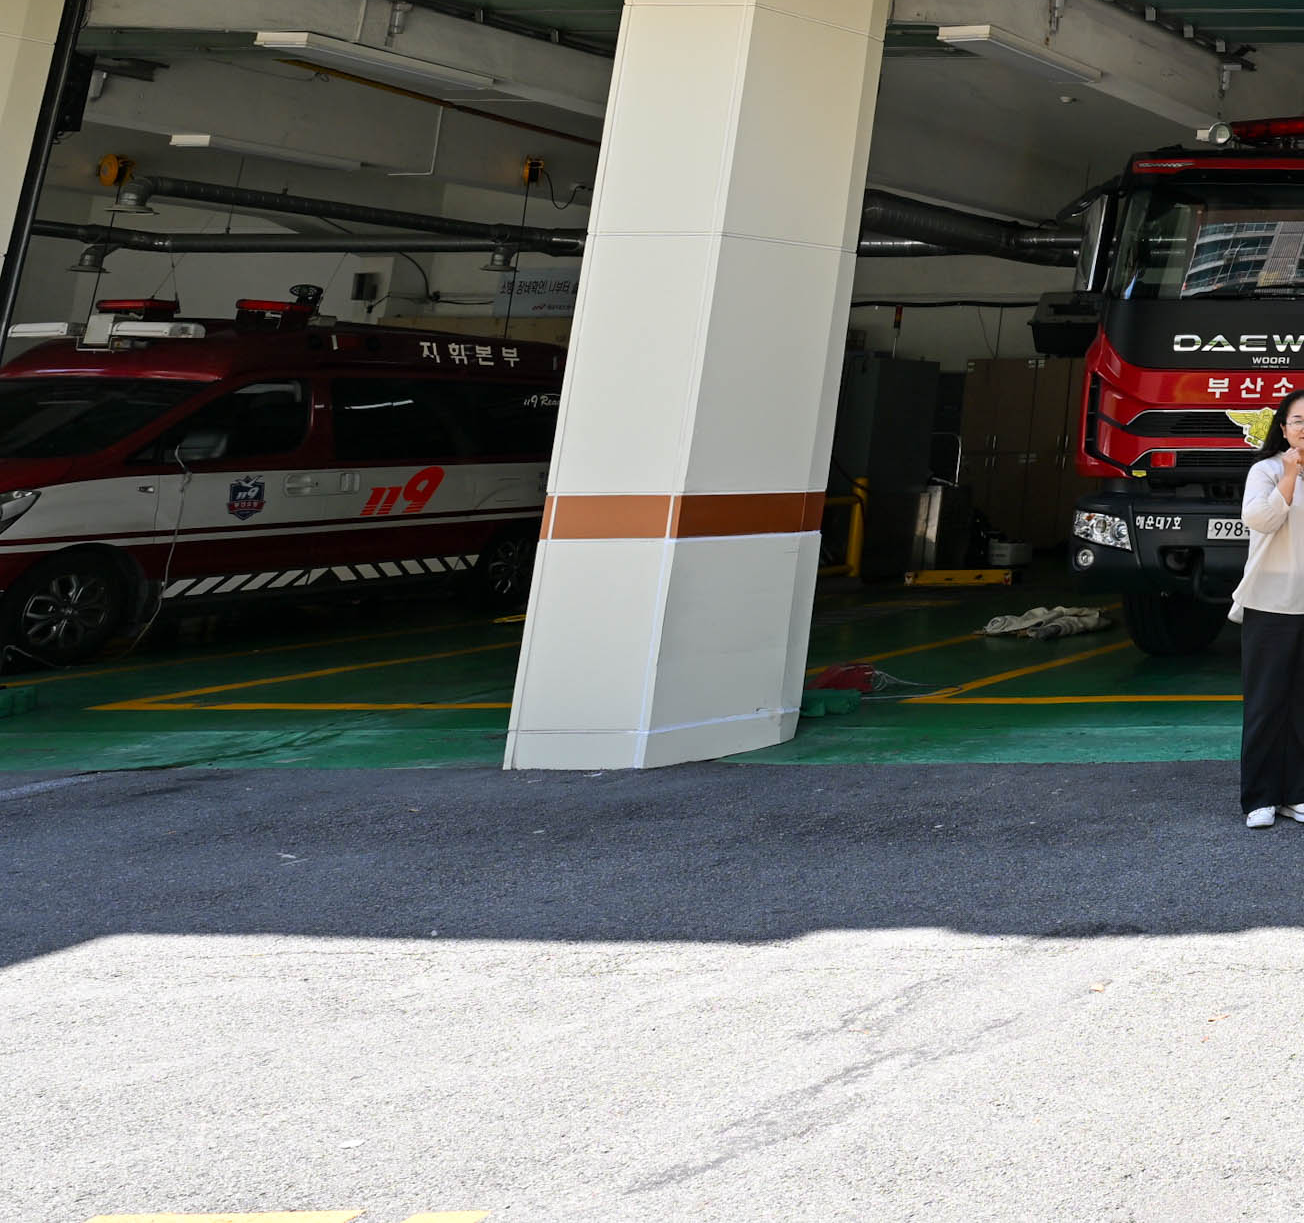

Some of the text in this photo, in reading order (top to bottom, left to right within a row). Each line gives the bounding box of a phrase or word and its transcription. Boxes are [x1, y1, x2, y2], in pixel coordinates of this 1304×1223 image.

[419, 341, 521, 368] 지휘본부
[1252, 356, 1290, 365] WOORI
[236, 486, 260, 500] 119
[359, 465, 445, 516] 119
